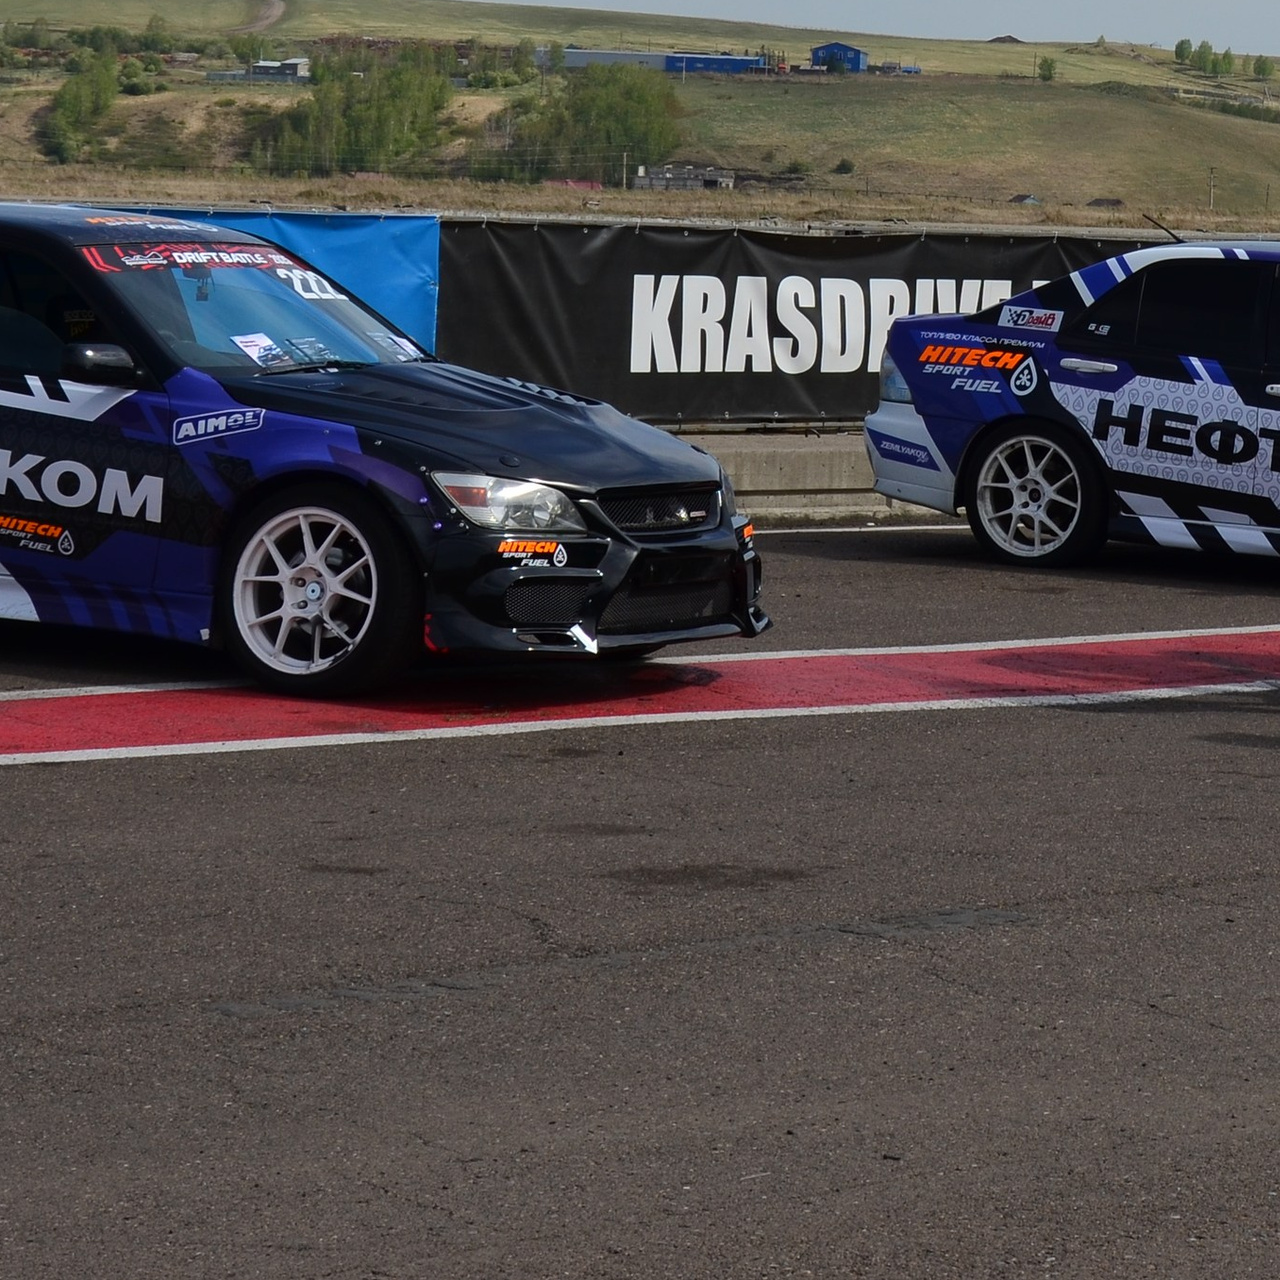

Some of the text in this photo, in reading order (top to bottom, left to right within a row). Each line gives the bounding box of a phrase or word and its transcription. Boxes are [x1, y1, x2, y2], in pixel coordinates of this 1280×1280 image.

[172, 251, 221, 264] DRIFT
[222, 252, 268, 264] BATTLE
[276, 268, 349, 300] 222
[920, 331, 1046, 349] ТОПЛИВО КЛАССА ПРЕМИУМ
[919, 345, 1024, 369] HITECH
[922, 364, 974, 376] SPORT
[951, 378, 1002, 393] FUEL
[177, 410, 259, 439] AIMOL
[880, 440, 928, 459] ZEMLYAKOV
[19, 539, 55, 552] FUEL
[498, 541, 557, 553] HITECH
[521, 559, 550, 567] FUEL
